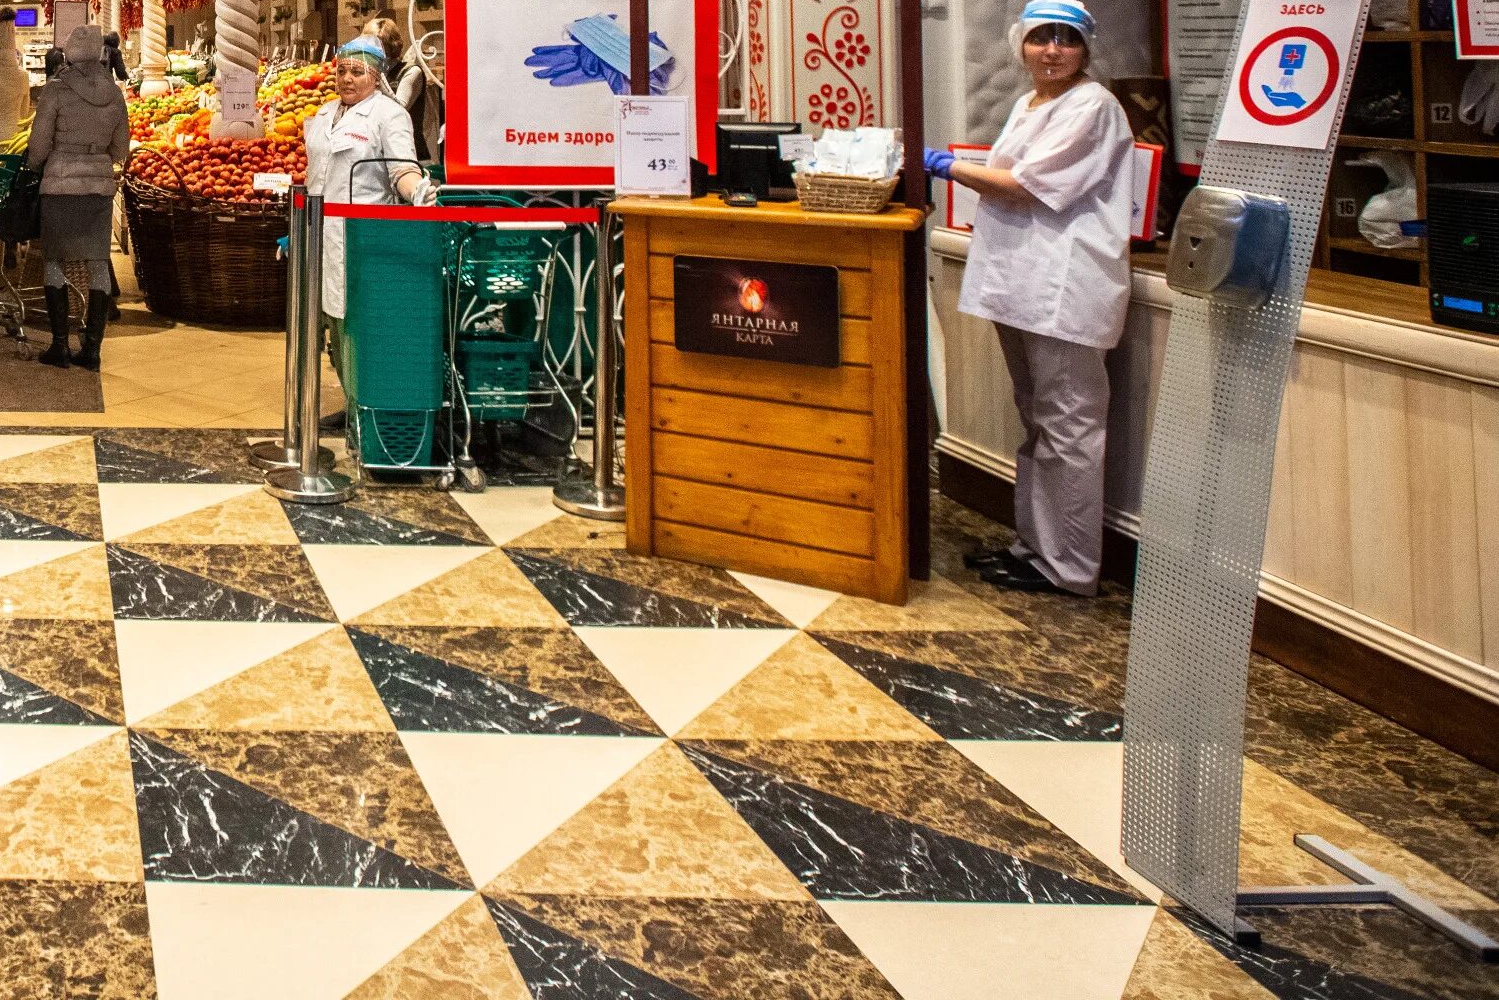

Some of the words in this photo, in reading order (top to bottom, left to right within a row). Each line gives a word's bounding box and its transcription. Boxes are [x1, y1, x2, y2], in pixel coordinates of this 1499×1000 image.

[1280, 1, 1325, 16] ЗДЕСЬ
[1434, 106, 1450, 120] 12
[505, 129, 560, 147] Будем
[564, 131, 614, 148] здоро
[648, 159, 666, 171] 43
[711, 313, 799, 334] ЯНТАРНАЯ
[735, 332, 775, 347] КАРТА
